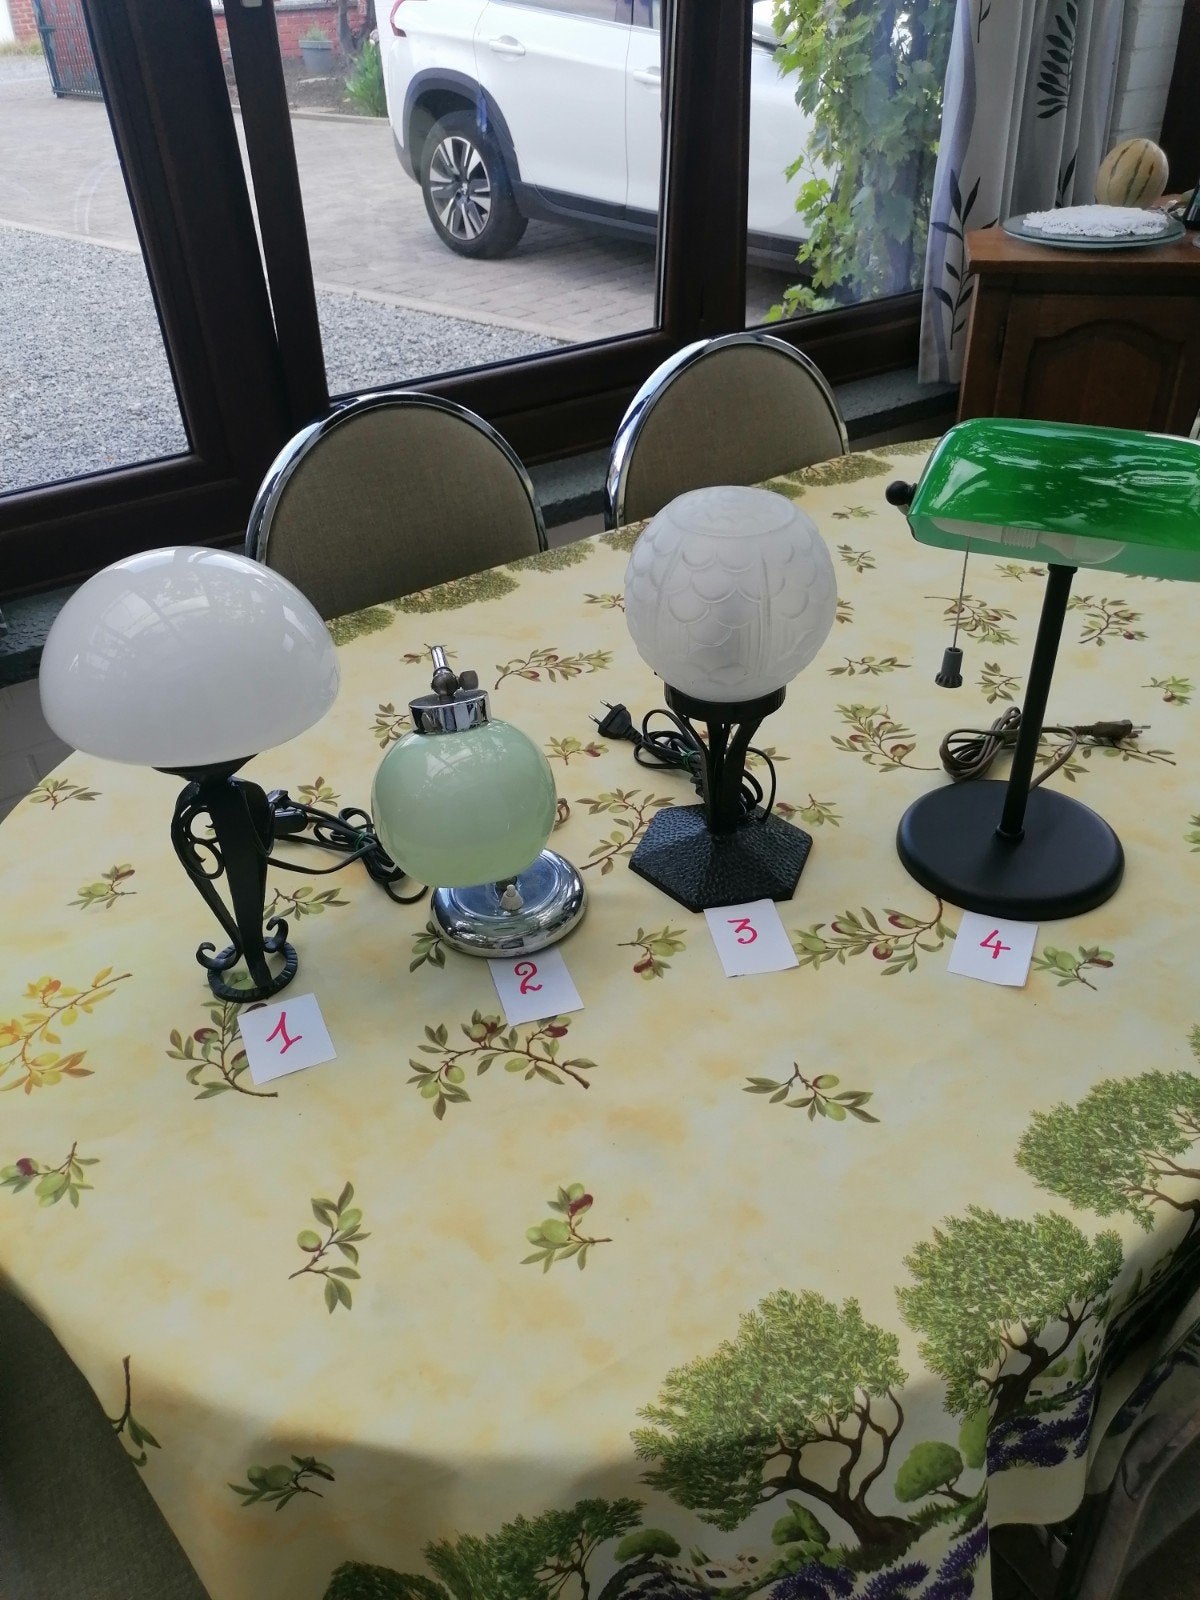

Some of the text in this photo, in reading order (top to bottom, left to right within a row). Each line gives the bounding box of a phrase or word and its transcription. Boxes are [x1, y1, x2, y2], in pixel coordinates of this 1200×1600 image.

[727, 918, 758, 944] 3
[979, 929, 1011, 959] 4
[514, 961, 542, 994] 2
[266, 1011, 302, 1054] 1
